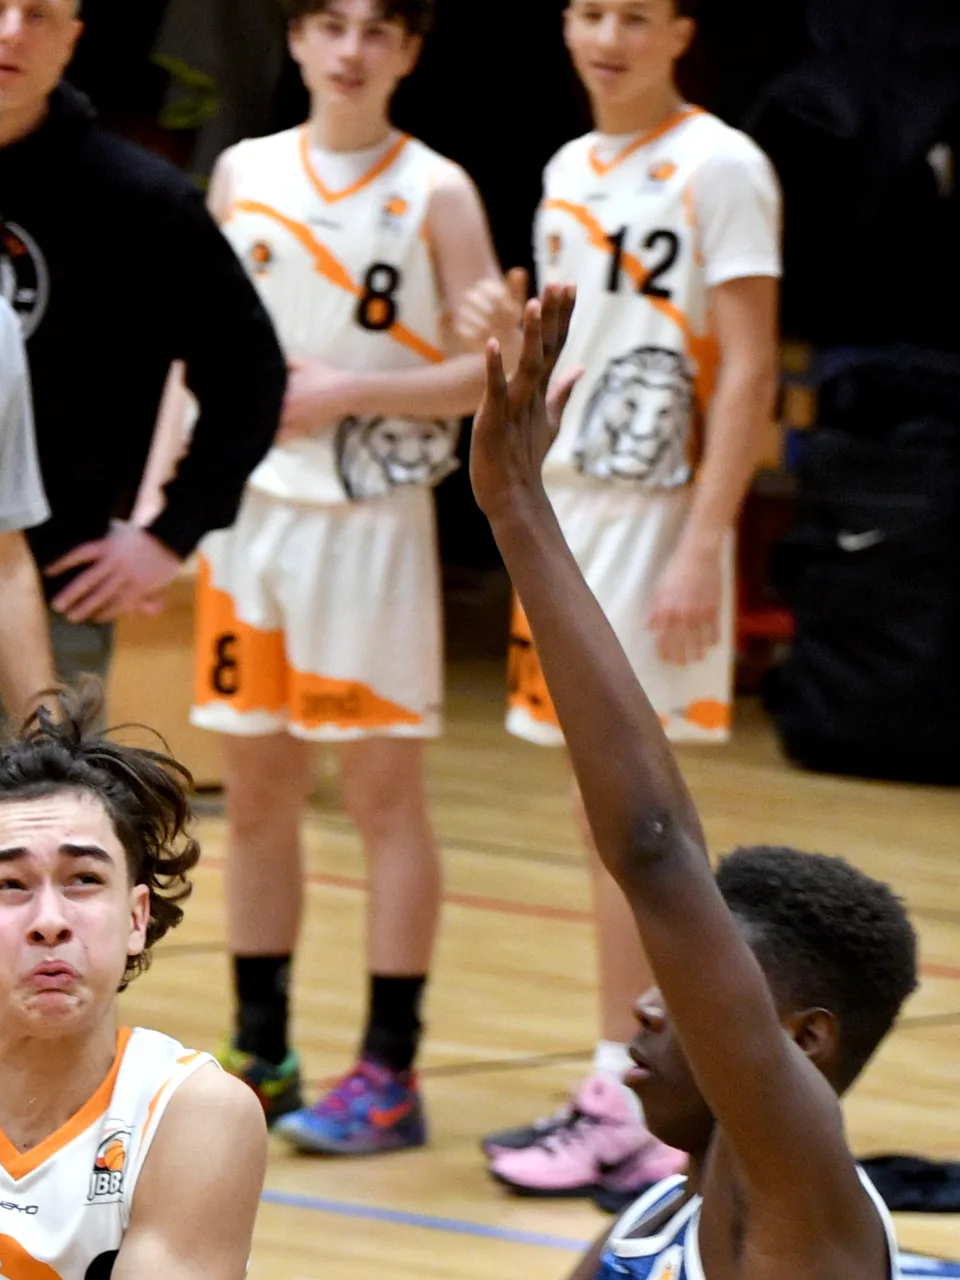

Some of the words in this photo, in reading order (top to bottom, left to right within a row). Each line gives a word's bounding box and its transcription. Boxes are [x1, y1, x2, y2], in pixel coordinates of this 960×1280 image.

[604, 222, 681, 299] 12
[355, 262, 400, 331] 8
[86, 1170, 125, 1201] JBB
